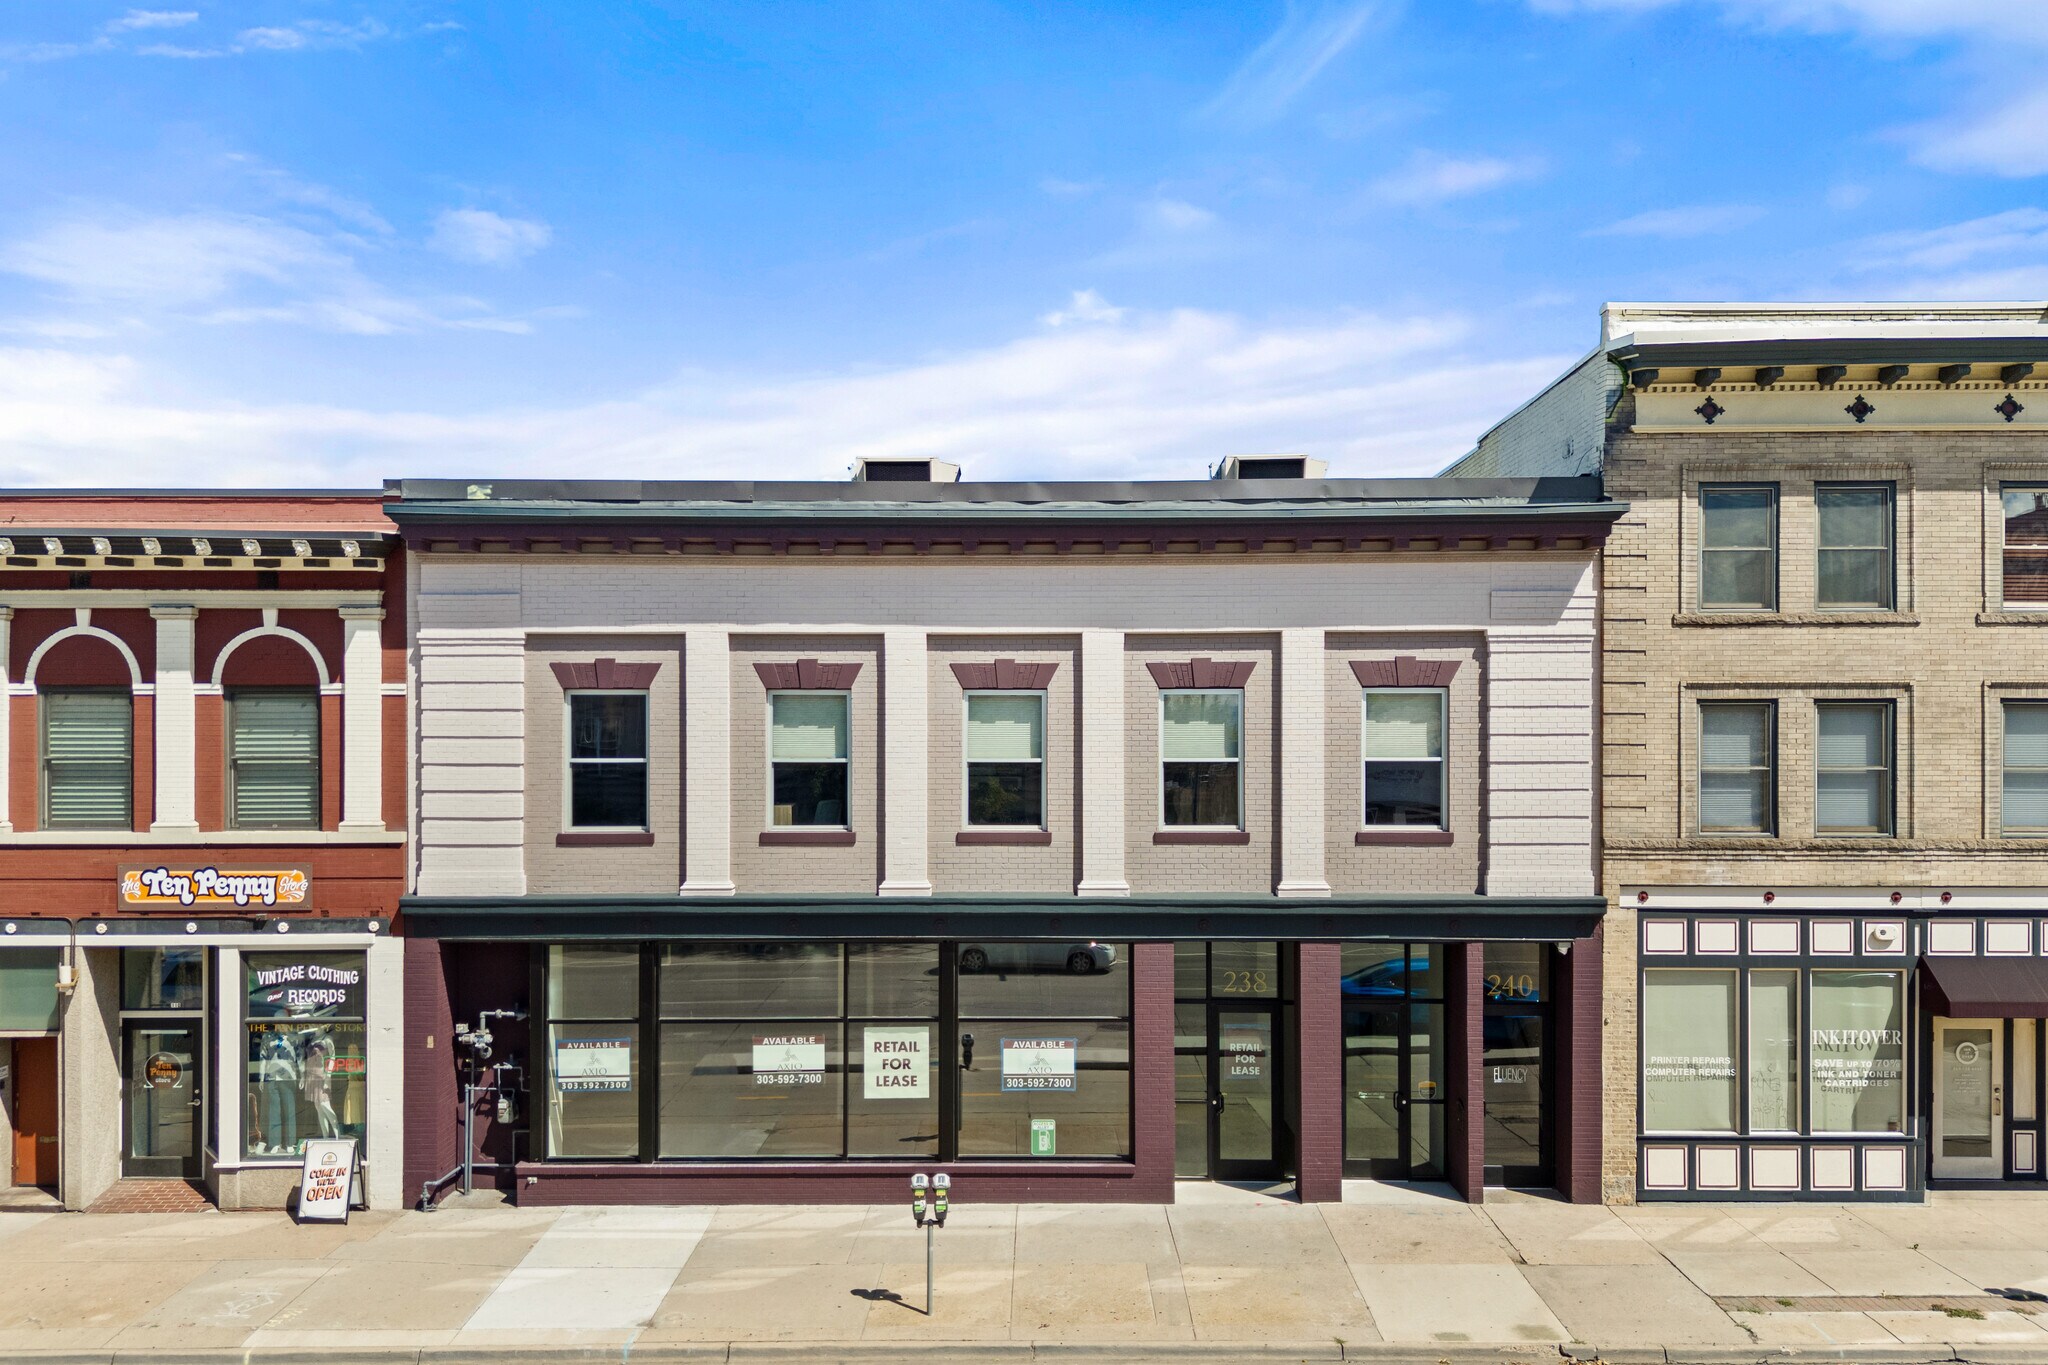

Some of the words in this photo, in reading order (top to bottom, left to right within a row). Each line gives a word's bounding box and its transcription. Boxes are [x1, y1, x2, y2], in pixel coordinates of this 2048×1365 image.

[140, 867, 195, 905] Ten
[193, 867, 277, 906] Penny
[279, 870, 308, 895] Store
[257, 965, 305, 985] VINTAGE
[308, 965, 359, 985] CLOTHING
[1223, 971, 1267, 993] 238
[1487, 974, 1533, 997] 240
[267, 990, 284, 1002] and
[288, 989, 346, 1005] RECORDS
[249, 1023, 269, 1032] THE
[567, 1041, 621, 1050] AVAILABLE
[763, 1036, 816, 1046] AVAILABLE
[1012, 1041, 1066, 1049] AVAILABLE
[873, 1041, 921, 1053] RETAIL
[1230, 1043, 1262, 1052] RETAIL
[882, 1058, 912, 1070] FOR
[1235, 1055, 1256, 1064] FOR
[1651, 1056, 1690, 1064] PRINTER
[1692, 1056, 1731, 1065] REPAIRS
[1814, 1059, 1844, 1068] SAVE
[1846, 1060, 1859, 1068] UP
[1860, 1060, 1873, 1068] TO
[1876, 1059, 1901, 1068] 70%
[324, 1058, 365, 1072] OPEN
[149, 1068, 177, 1078] Penny
[581, 1068, 608, 1076] AXIO
[1231, 1067, 1260, 1075] LEASE
[1645, 1068, 1697, 1076] COMPUTER
[1698, 1068, 1736, 1077] REPAIRS
[756, 1074, 822, 1084] 303-592-7300
[876, 1076, 918, 1087] LEASE
[1006, 1078, 1072, 1088] 303-592-7300
[561, 1081, 628, 1090] 303.592.7300
[309, 1168, 335, 1180] COME
[335, 1166, 348, 1177] IN
[306, 1185, 345, 1202] OPEN
